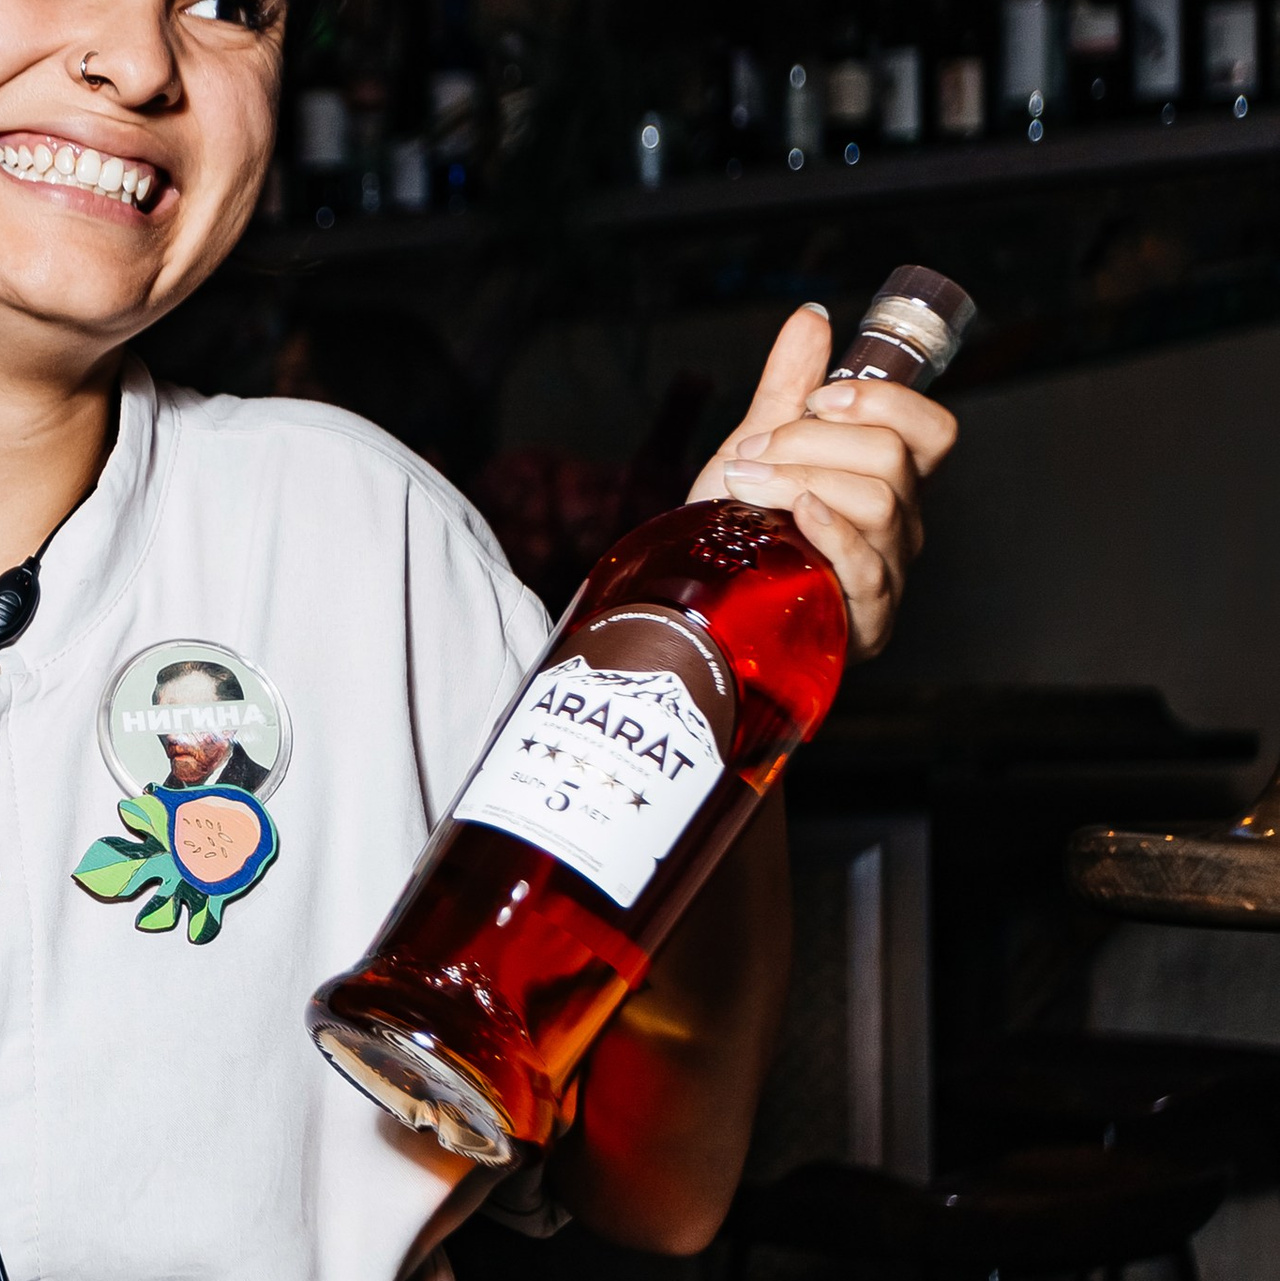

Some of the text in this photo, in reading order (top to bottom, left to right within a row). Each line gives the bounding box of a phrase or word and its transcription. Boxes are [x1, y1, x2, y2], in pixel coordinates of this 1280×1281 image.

[121, 703, 266, 733] НИГИНА
[529, 683, 696, 781] ARARAT
[545, 780, 581, 812] 5
